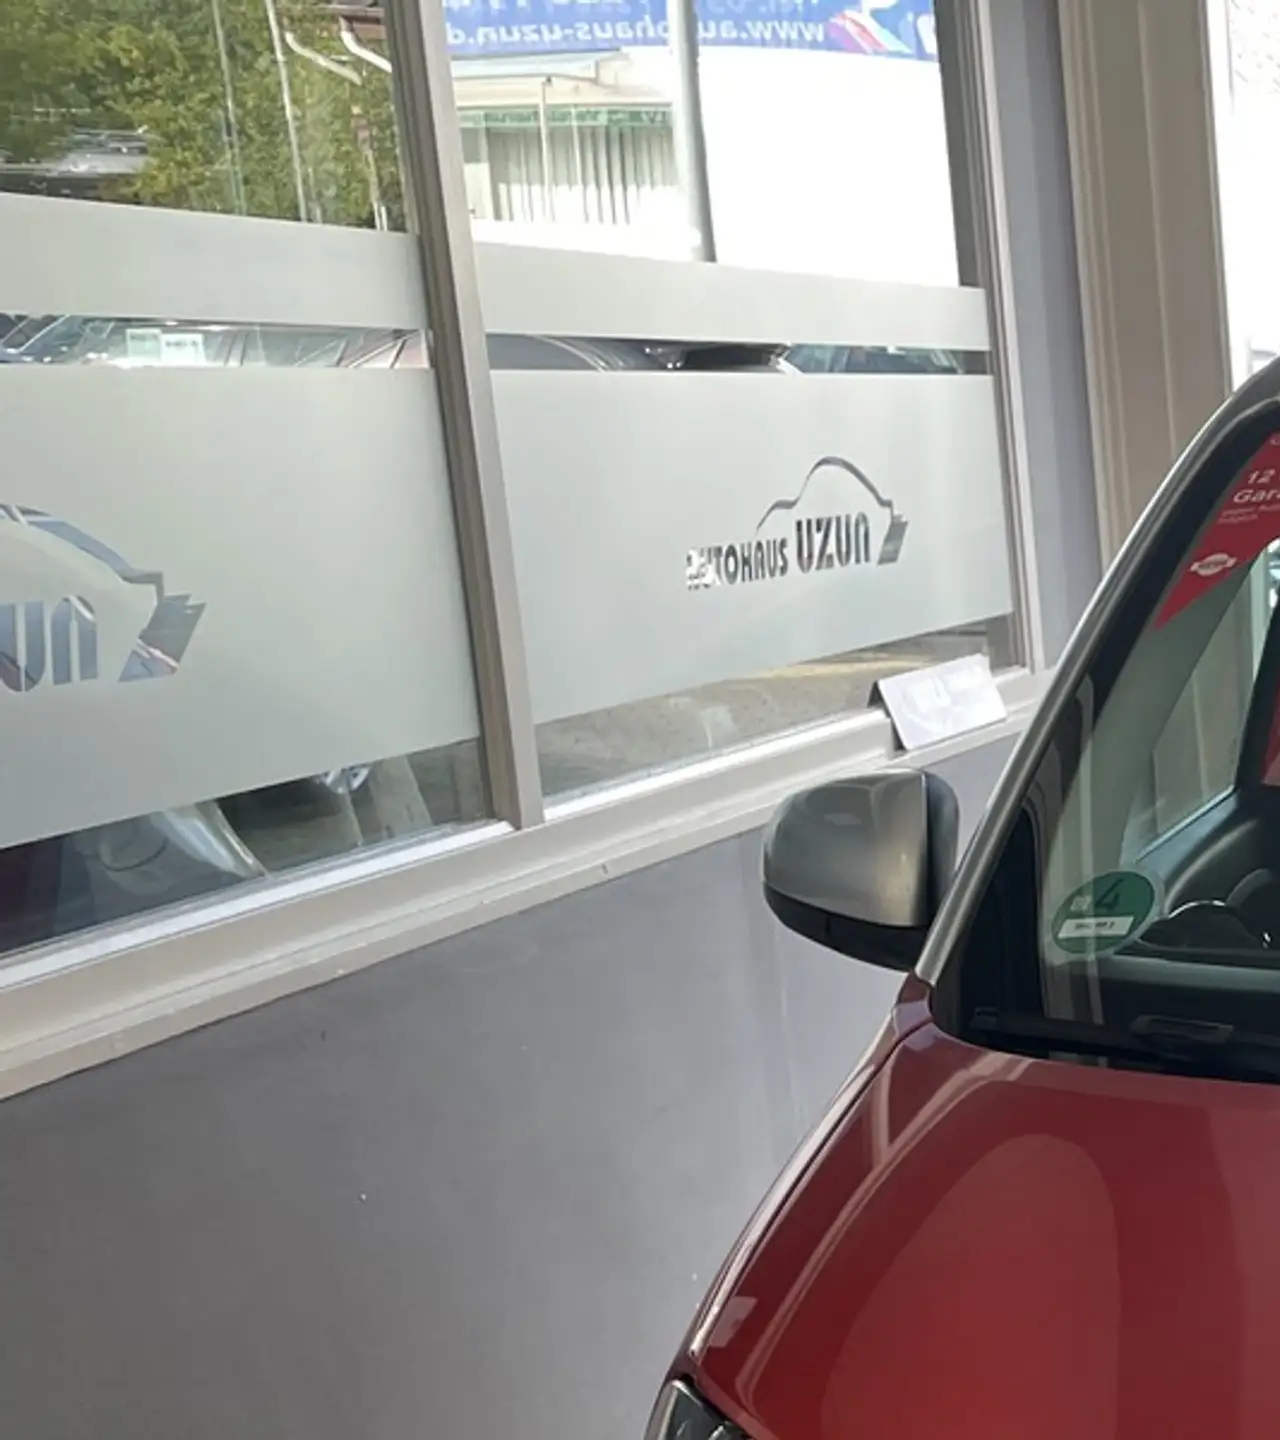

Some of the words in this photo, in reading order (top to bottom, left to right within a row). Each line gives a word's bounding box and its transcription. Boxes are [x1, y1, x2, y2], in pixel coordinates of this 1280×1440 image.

[1247, 468, 1276, 485] 12
[795, 511, 871, 574] UZUN
[1094, 877, 1125, 911] 4
